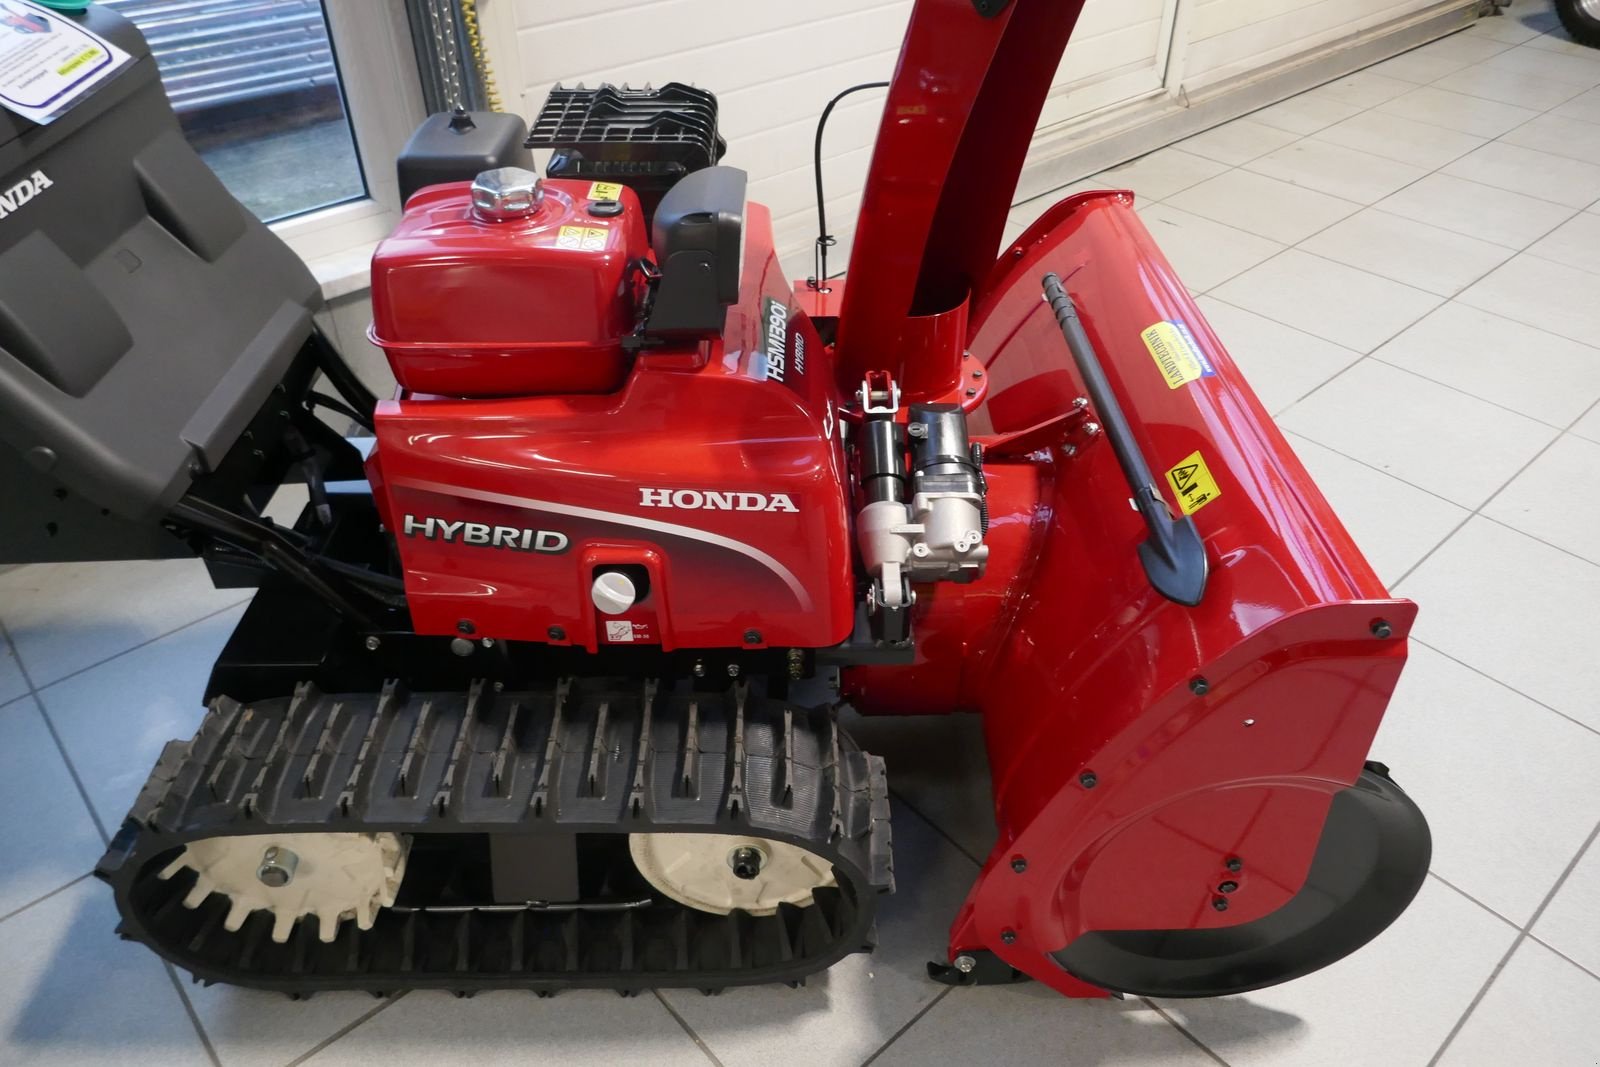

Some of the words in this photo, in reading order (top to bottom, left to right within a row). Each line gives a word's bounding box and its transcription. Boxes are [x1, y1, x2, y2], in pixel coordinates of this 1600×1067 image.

[766, 300, 787, 382] HSM1390i
[794, 332, 805, 375] HYBRID
[1146, 329, 1184, 385] LANDTECHNIK
[639, 487, 800, 513] HONDA
[404, 514, 568, 552] HYBRID
